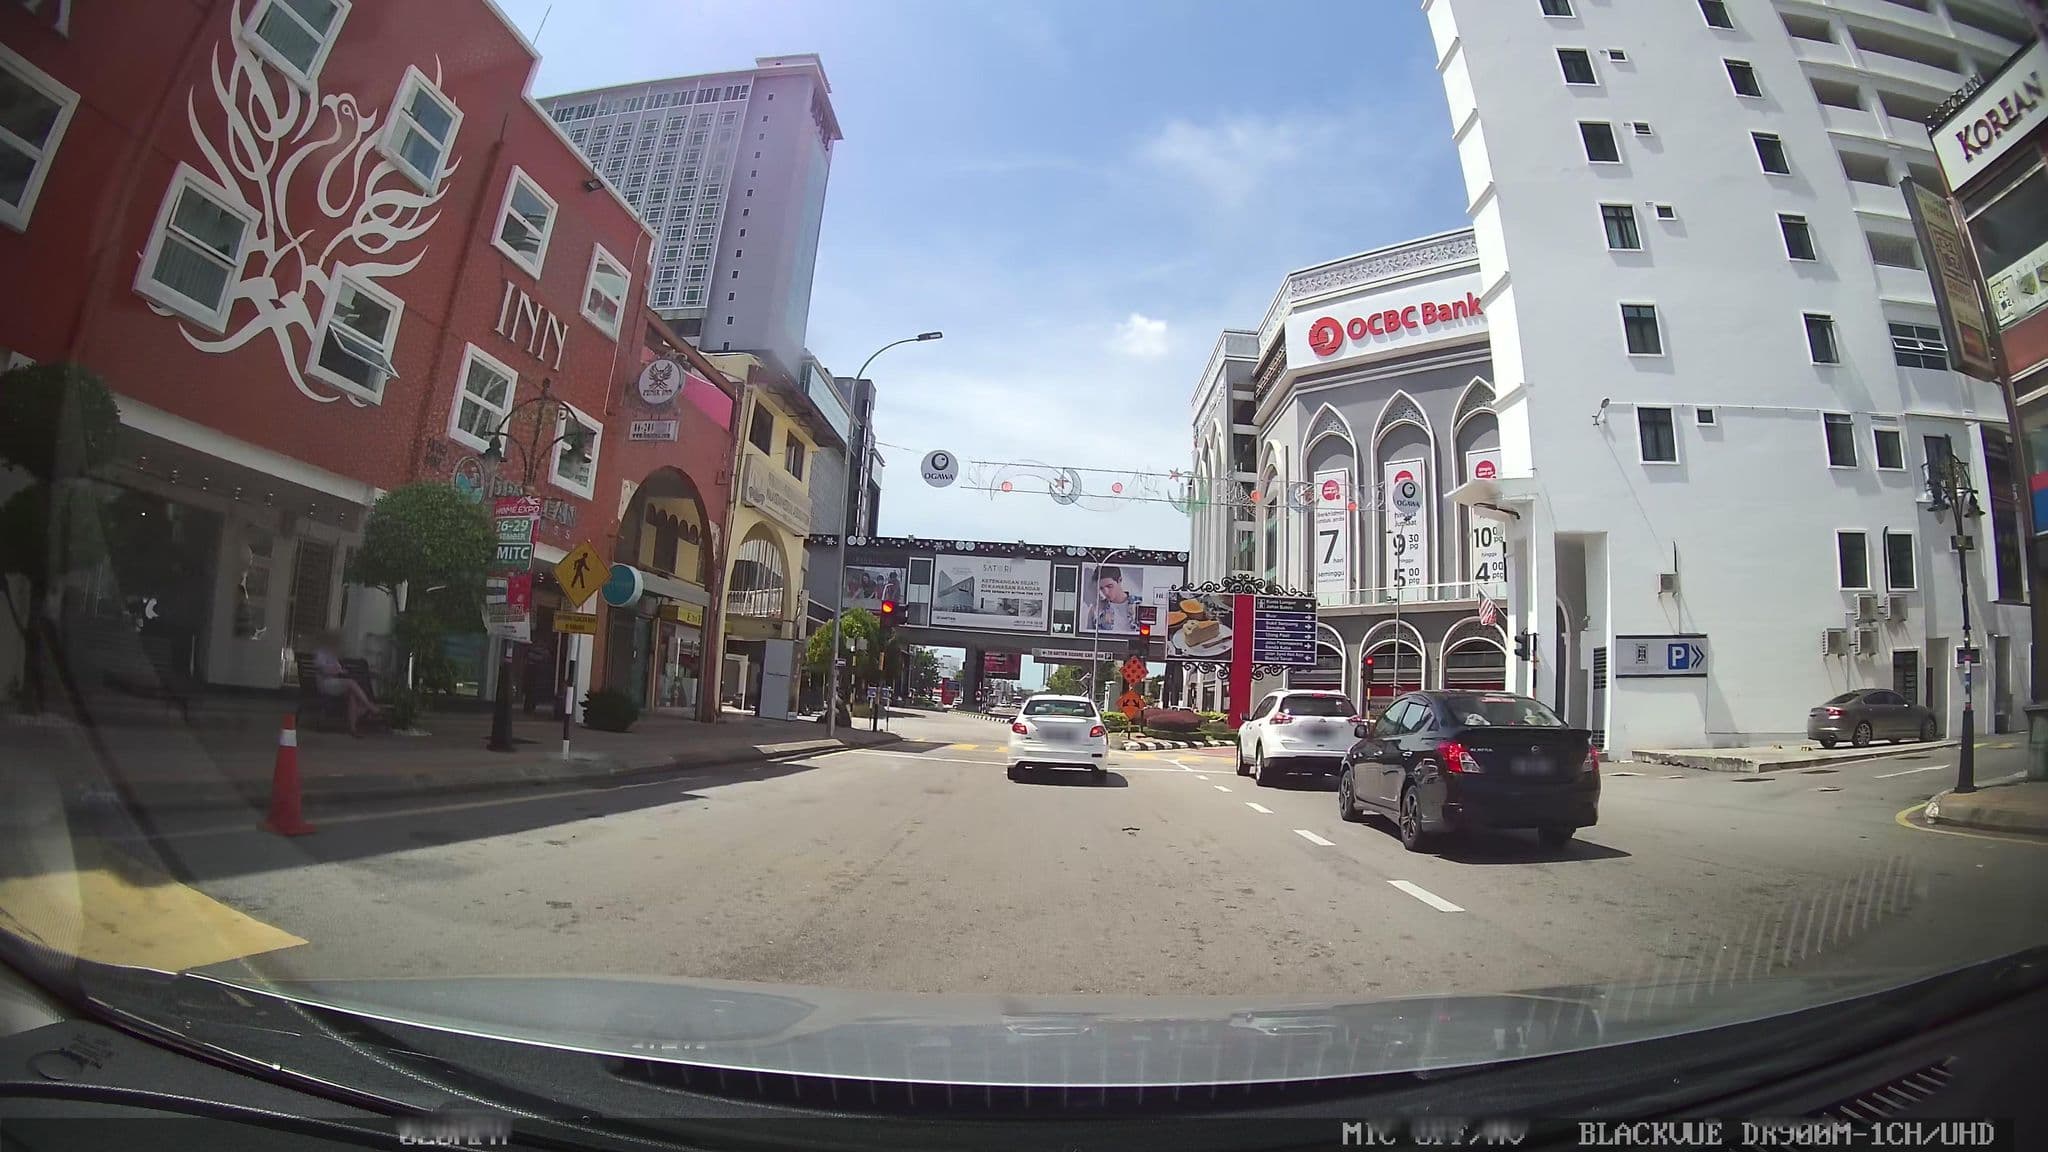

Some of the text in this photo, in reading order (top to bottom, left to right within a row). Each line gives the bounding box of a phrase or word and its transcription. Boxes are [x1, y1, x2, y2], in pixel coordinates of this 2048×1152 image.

[1955, 71, 2047, 162] KOREAN
[494, 280, 569, 372] INN
[1346, 292, 1484, 341] OCBC Bank
[924, 472, 954, 480] OGAWA
[496, 505, 540, 515] HOME EXPO
[1396, 500, 1420, 508] OGAWA
[1319, 529, 1340, 564] 7
[1393, 533, 1419, 556] 9 30
[1473, 527, 1492, 548] 10
[496, 546, 530, 561] MITC
[1393, 568, 1420, 588] 5 00
[1475, 561, 1504, 583] 4 00
[1671, 646, 1685, 667] P
